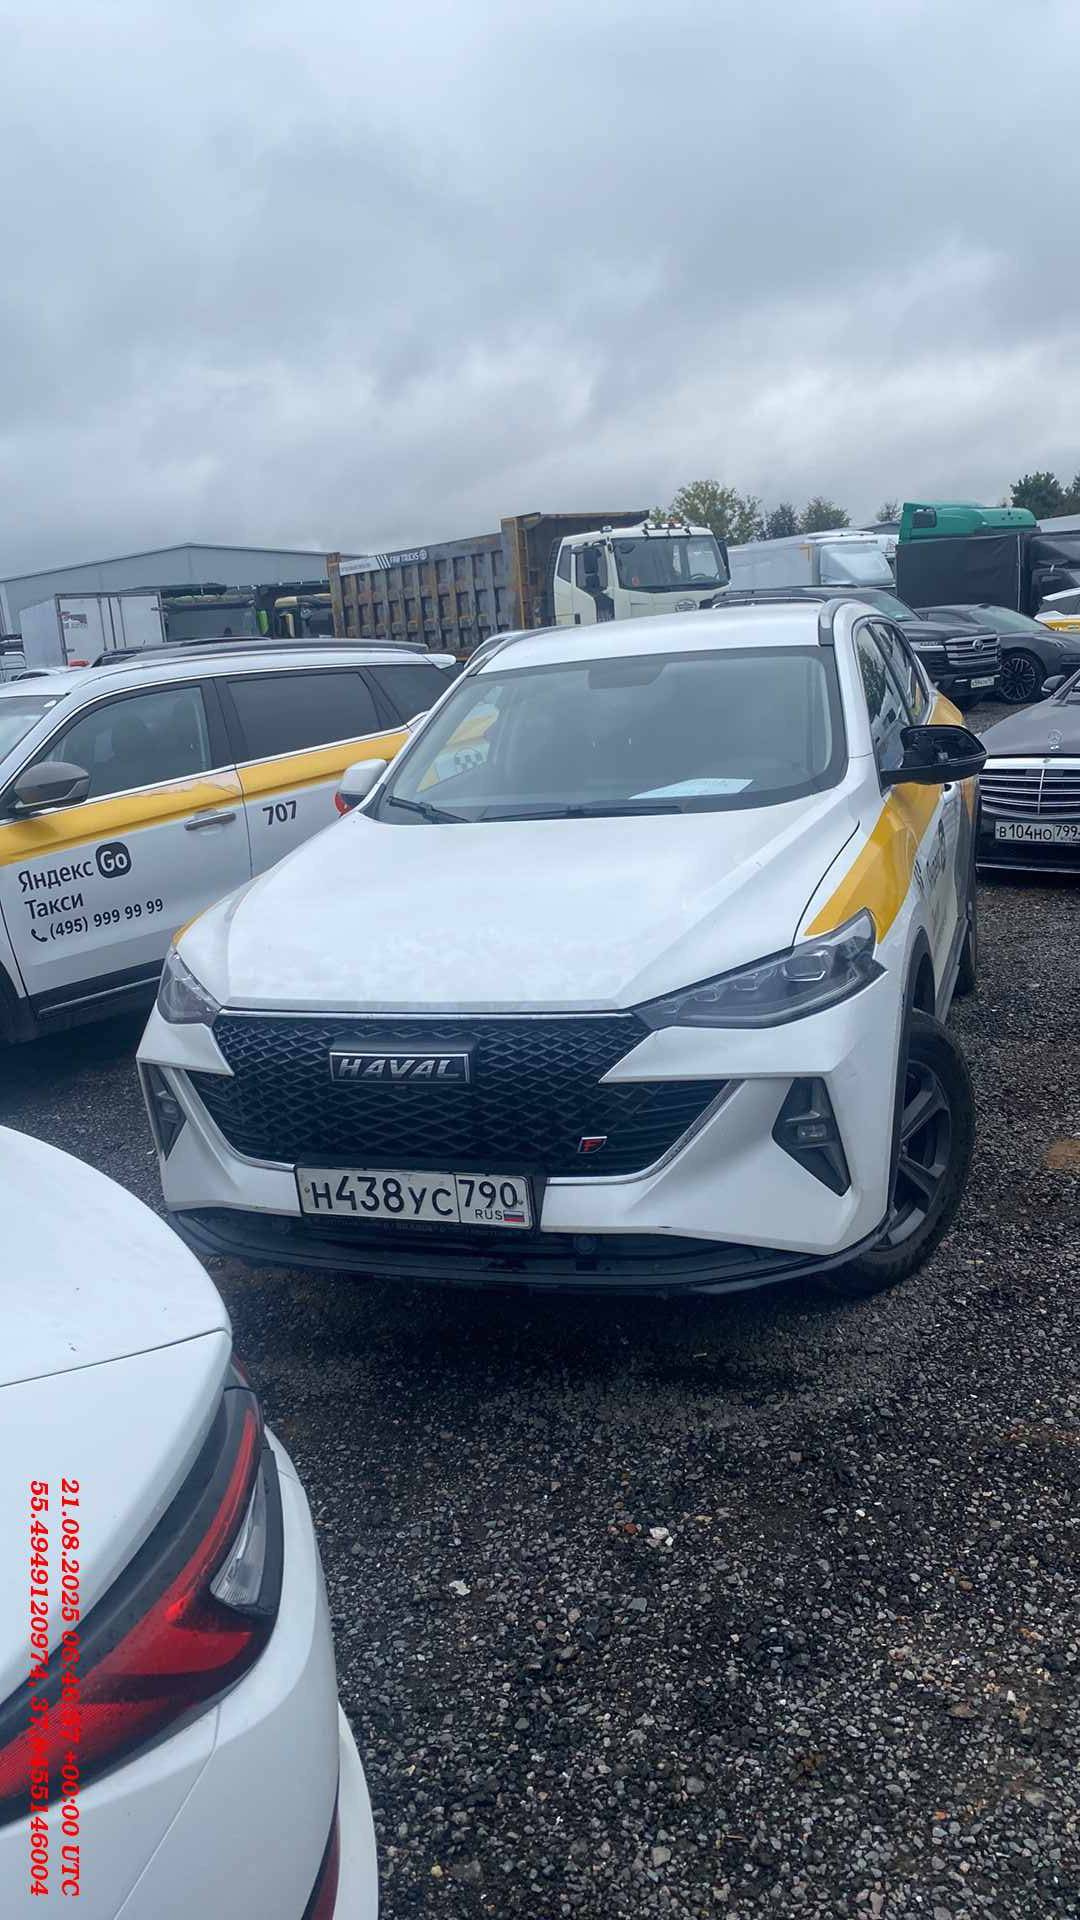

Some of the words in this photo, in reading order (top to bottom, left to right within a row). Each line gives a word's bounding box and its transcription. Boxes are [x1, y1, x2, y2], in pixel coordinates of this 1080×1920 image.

[262, 800, 298, 826] 707
[999, 823, 1053, 841] В104НО
[1055, 825, 1078, 838] 799
[18, 859, 95, 894] Яндекс
[98, 849, 129, 874] Go
[24, 892, 85, 920] Такси
[49, 915, 89, 941] (495)
[93, 905, 121, 928] 999
[124, 901, 142, 922] 99
[146, 898, 164, 919] 99
[338, 1057, 461, 1079] HAVAL
[582, 1139, 604, 1153] F
[310, 1174, 455, 1217] Н438УС
[458, 1178, 520, 1209] 790
[474, 1208, 504, 1221] RUS
